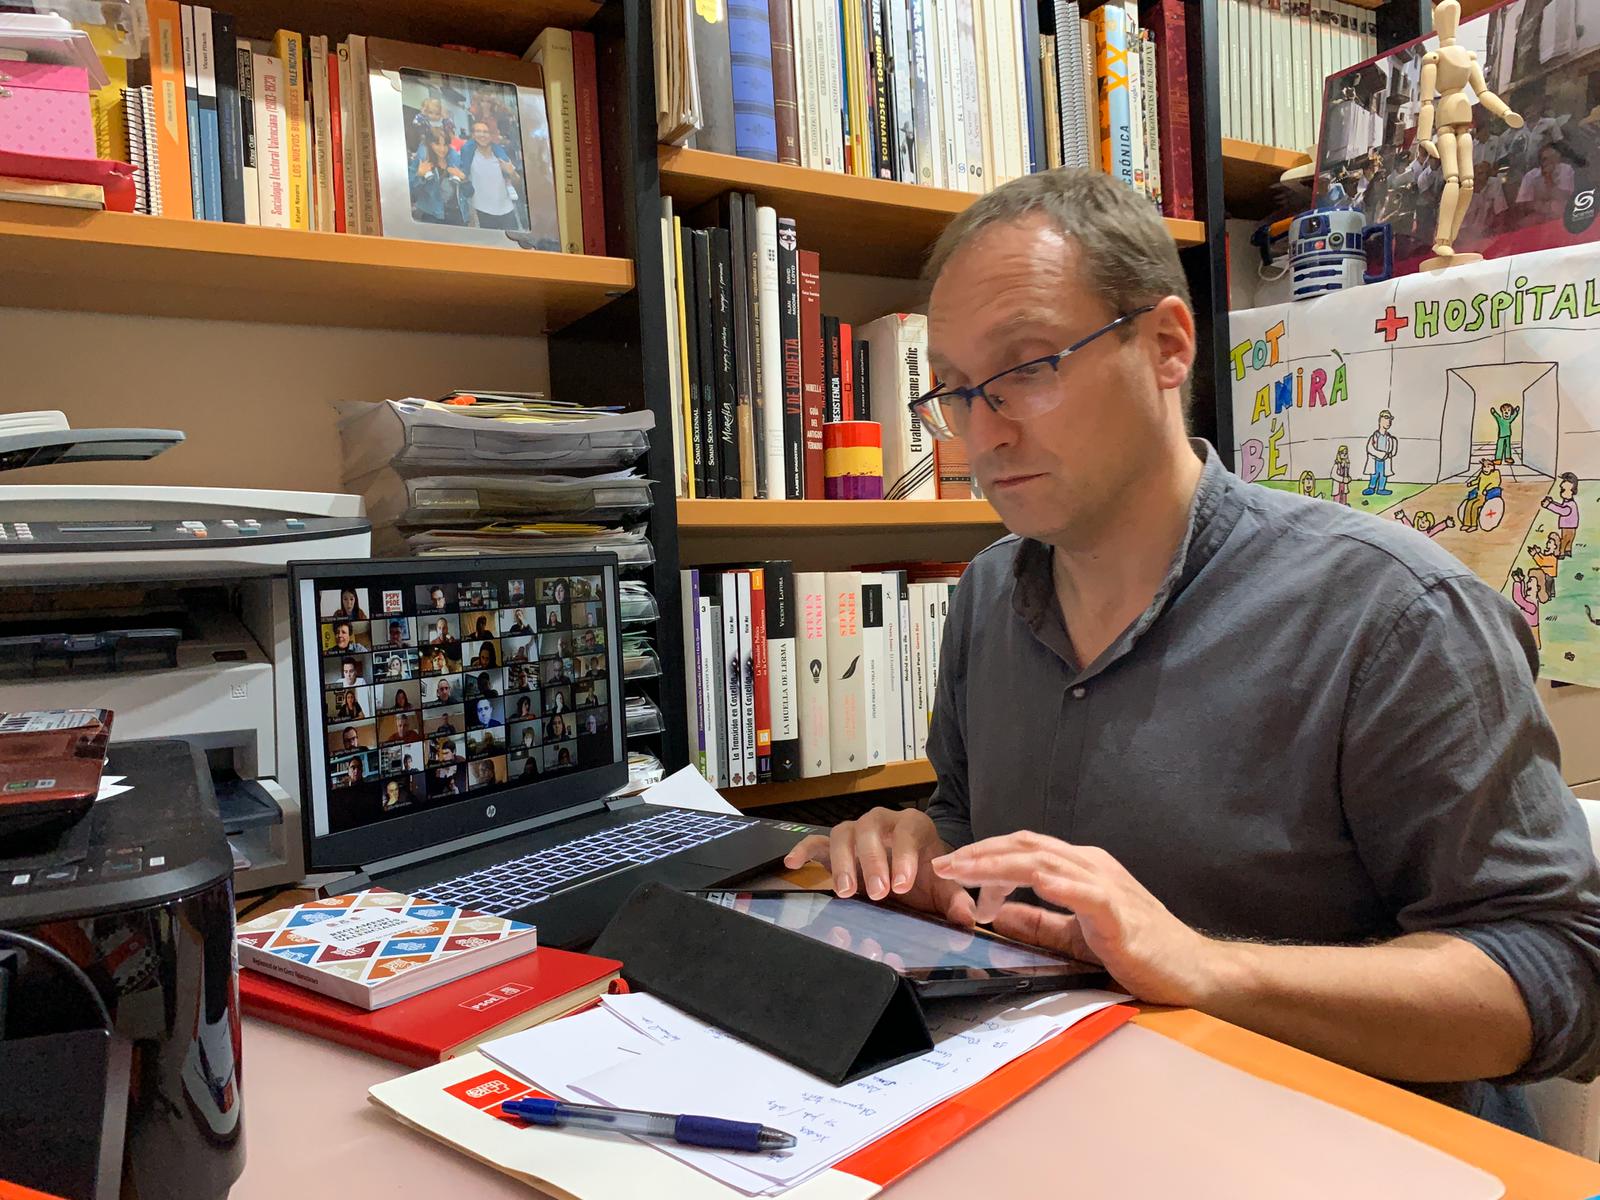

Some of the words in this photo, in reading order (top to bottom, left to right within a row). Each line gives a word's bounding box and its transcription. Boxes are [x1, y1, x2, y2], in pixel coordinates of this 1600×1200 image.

[287, 37, 298, 86] VALENCIANOS
[873, 35, 884, 82] MUNDOS
[1145, 45, 1153, 57] XX
[1145, 58, 1153, 78] SIGLO
[1146, 80, 1154, 93] DEL
[265, 113, 277, 149] Valenciana
[876, 96, 889, 161] ESCENARIOS
[1146, 94, 1157, 151] PROTAGONISTAS
[291, 133, 300, 161] NUEVOS
[1119, 124, 1132, 186] CRÓNICA
[292, 162, 301, 178] LOS
[1415, 276, 1600, 338] HOSPITAL
[784, 337, 800, 388] VENDETTA
[904, 347, 919, 376] polític
[1230, 320, 1286, 381] TOT
[786, 390, 800, 404] DE
[786, 405, 801, 414] V
[830, 377, 841, 422] RESISTENCIA
[911, 443, 922, 452] El
[1241, 418, 1288, 483] BÉ
[805, 593, 814, 639] STEVEN
[814, 593, 823, 638] PINKER
[848, 592, 856, 635] PINKER
[779, 642, 788, 672] LERMA
[728, 676, 737, 706] Castellón
[743, 676, 752, 706] Castellón
[781, 674, 788, 685] DE
[732, 708, 737, 716] en
[746, 707, 752, 716] en
[781, 688, 790, 721] HUELLA
[730, 718, 739, 750] Transición
[744, 717, 754, 749] Transición
[783, 723, 790, 734] LA
[732, 751, 740, 760] La
[747, 750, 755, 759] La
